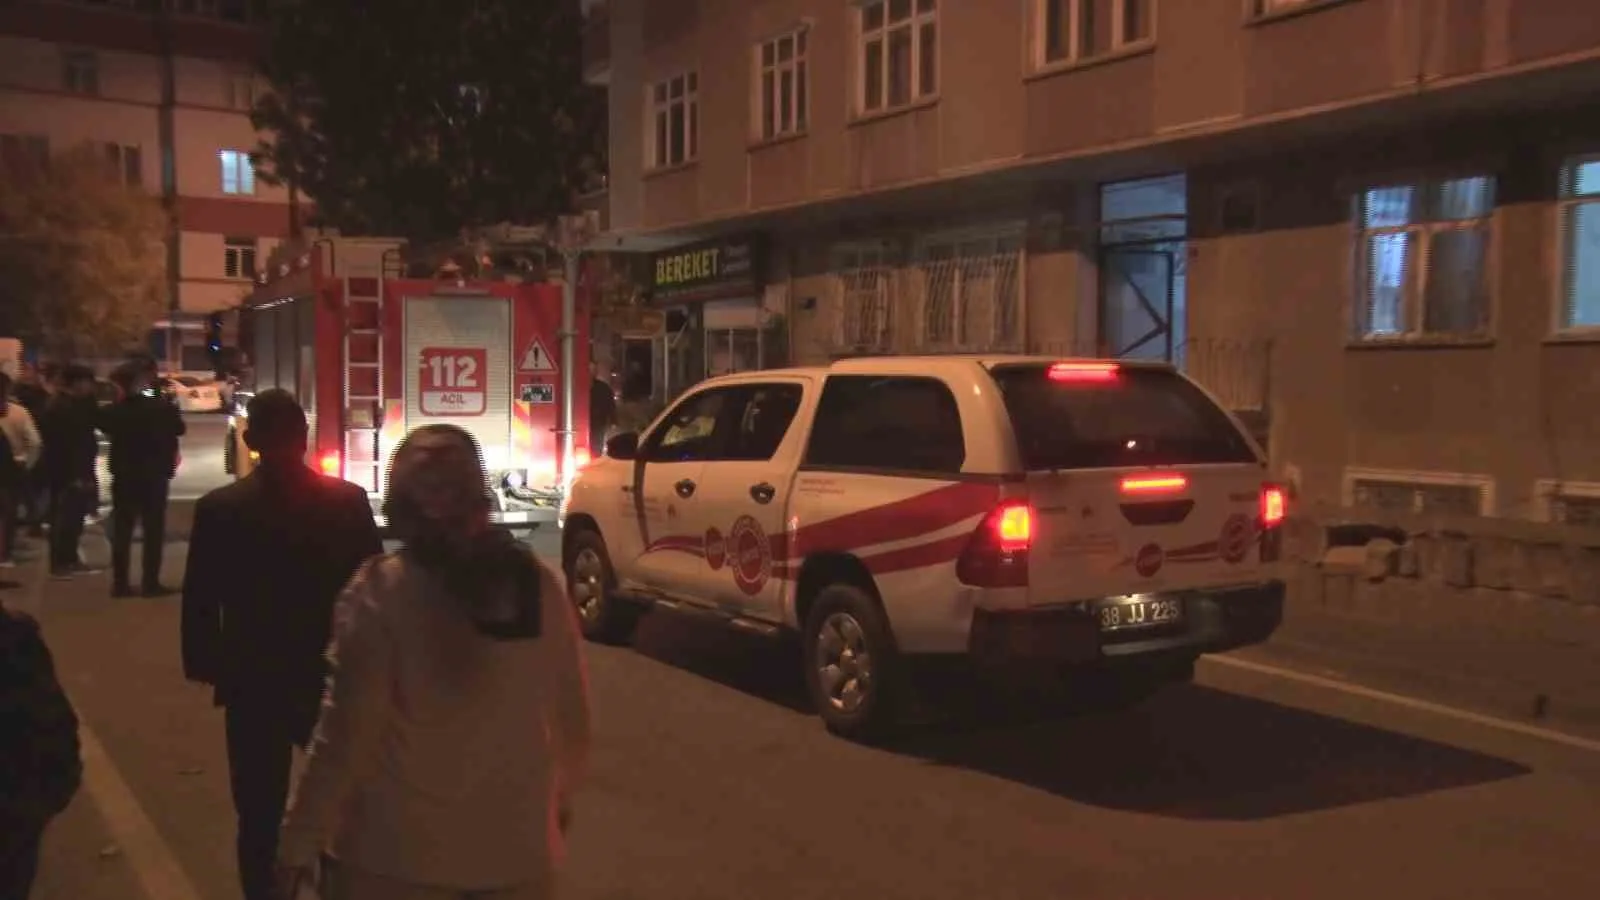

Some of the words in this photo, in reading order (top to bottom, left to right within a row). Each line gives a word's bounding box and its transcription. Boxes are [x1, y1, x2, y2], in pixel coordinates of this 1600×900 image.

[655, 248, 719, 285] BEREKET
[429, 355, 477, 387] 112
[1101, 606, 1120, 627] 38
[1127, 603, 1145, 623] JJ
[1151, 601, 1179, 621] 225
